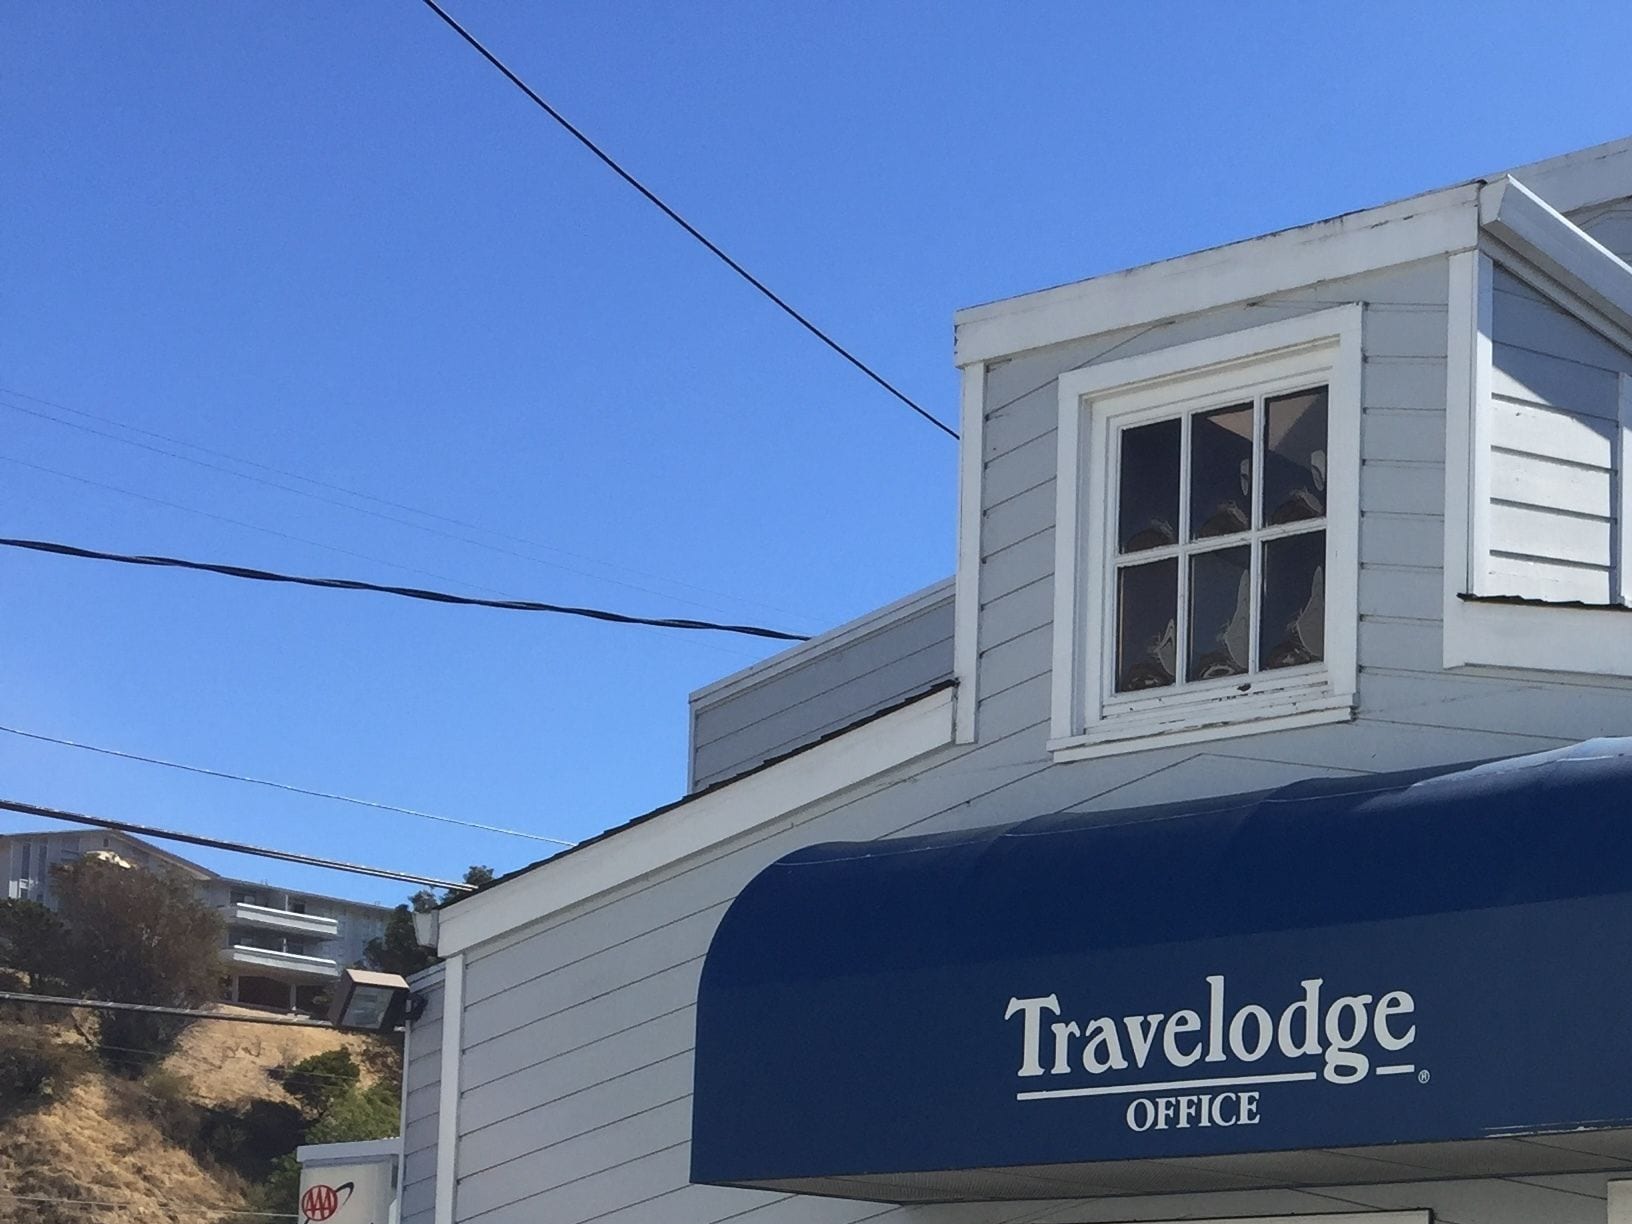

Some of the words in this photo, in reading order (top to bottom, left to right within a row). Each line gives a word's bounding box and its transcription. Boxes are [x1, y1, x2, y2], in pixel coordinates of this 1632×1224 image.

[1005, 975, 1416, 1084] Travelodge
[1127, 1092, 1260, 1131] OFFICE
[304, 1186, 335, 1220] AAA
